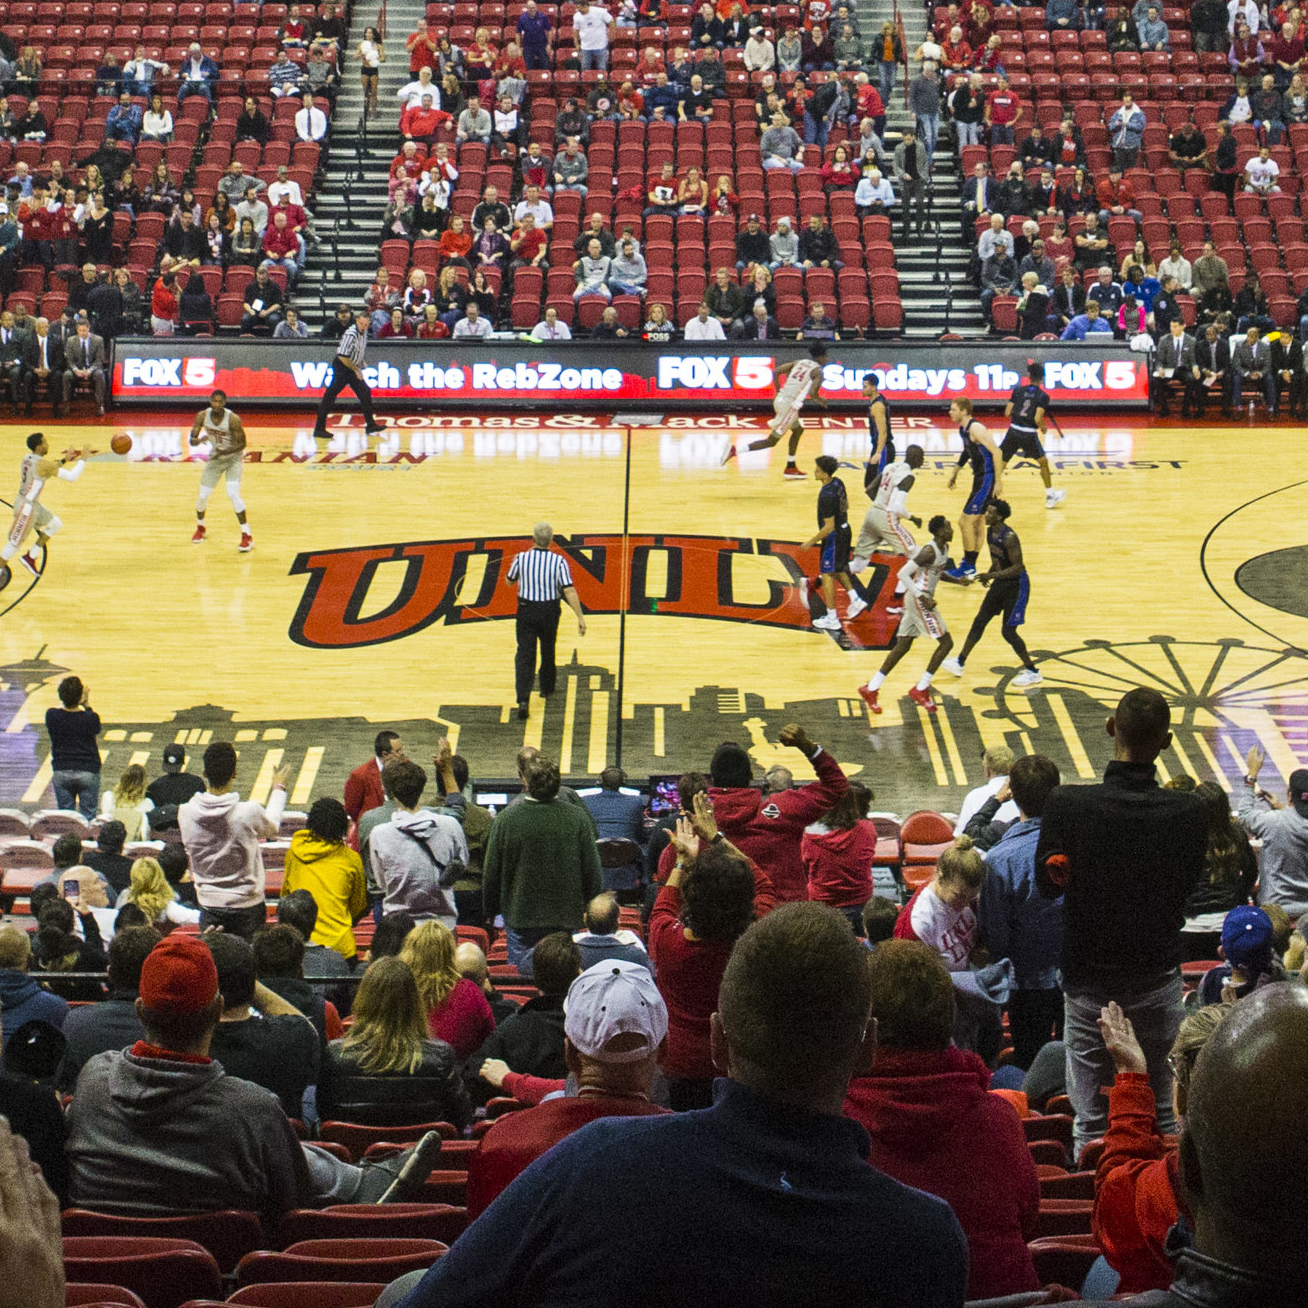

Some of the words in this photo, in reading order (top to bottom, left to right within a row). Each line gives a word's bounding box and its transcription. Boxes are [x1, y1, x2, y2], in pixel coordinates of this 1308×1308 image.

[648, 333, 670, 342] POSS
[123, 359, 182, 386] FOX
[185, 359, 216, 386] 5
[408, 362, 465, 389] the
[473, 363, 623, 390] RebZone
[658, 356, 730, 389] FOX
[734, 357, 774, 389] 5
[792, 366, 808, 383] 24
[1045, 362, 1101, 389] FOX
[1104, 361, 1136, 390] 5
[1019, 400, 1032, 418] 2
[544, 414, 608, 428] &
[1056, 460, 1189, 470] FIRST
